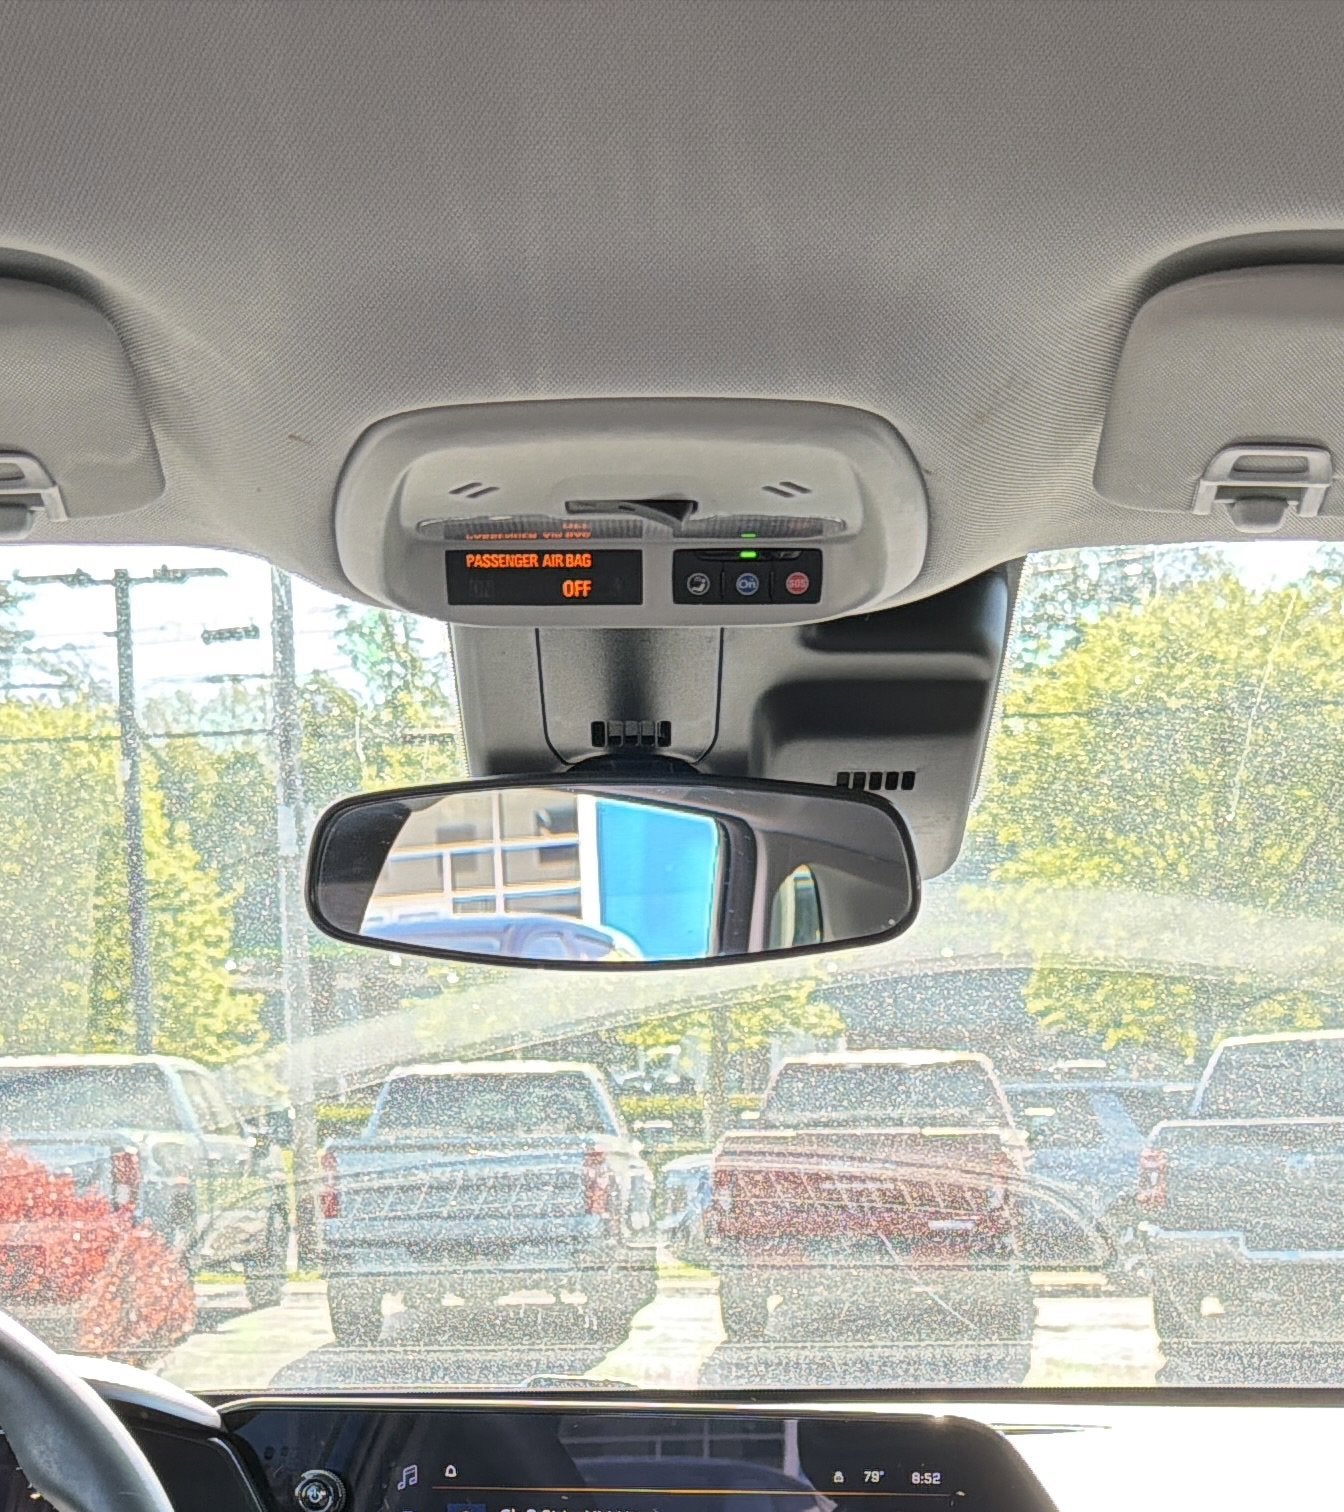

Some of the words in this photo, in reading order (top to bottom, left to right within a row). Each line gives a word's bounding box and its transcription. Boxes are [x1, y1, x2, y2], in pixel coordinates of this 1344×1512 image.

[466, 553, 539, 568] PASSENGER
[542, 553, 564, 568] AIR
[565, 553, 592, 568] BAG
[562, 579, 592, 599] OFF
[788, 577, 808, 589] SOS
[911, 1471, 942, 1485] 8:52
